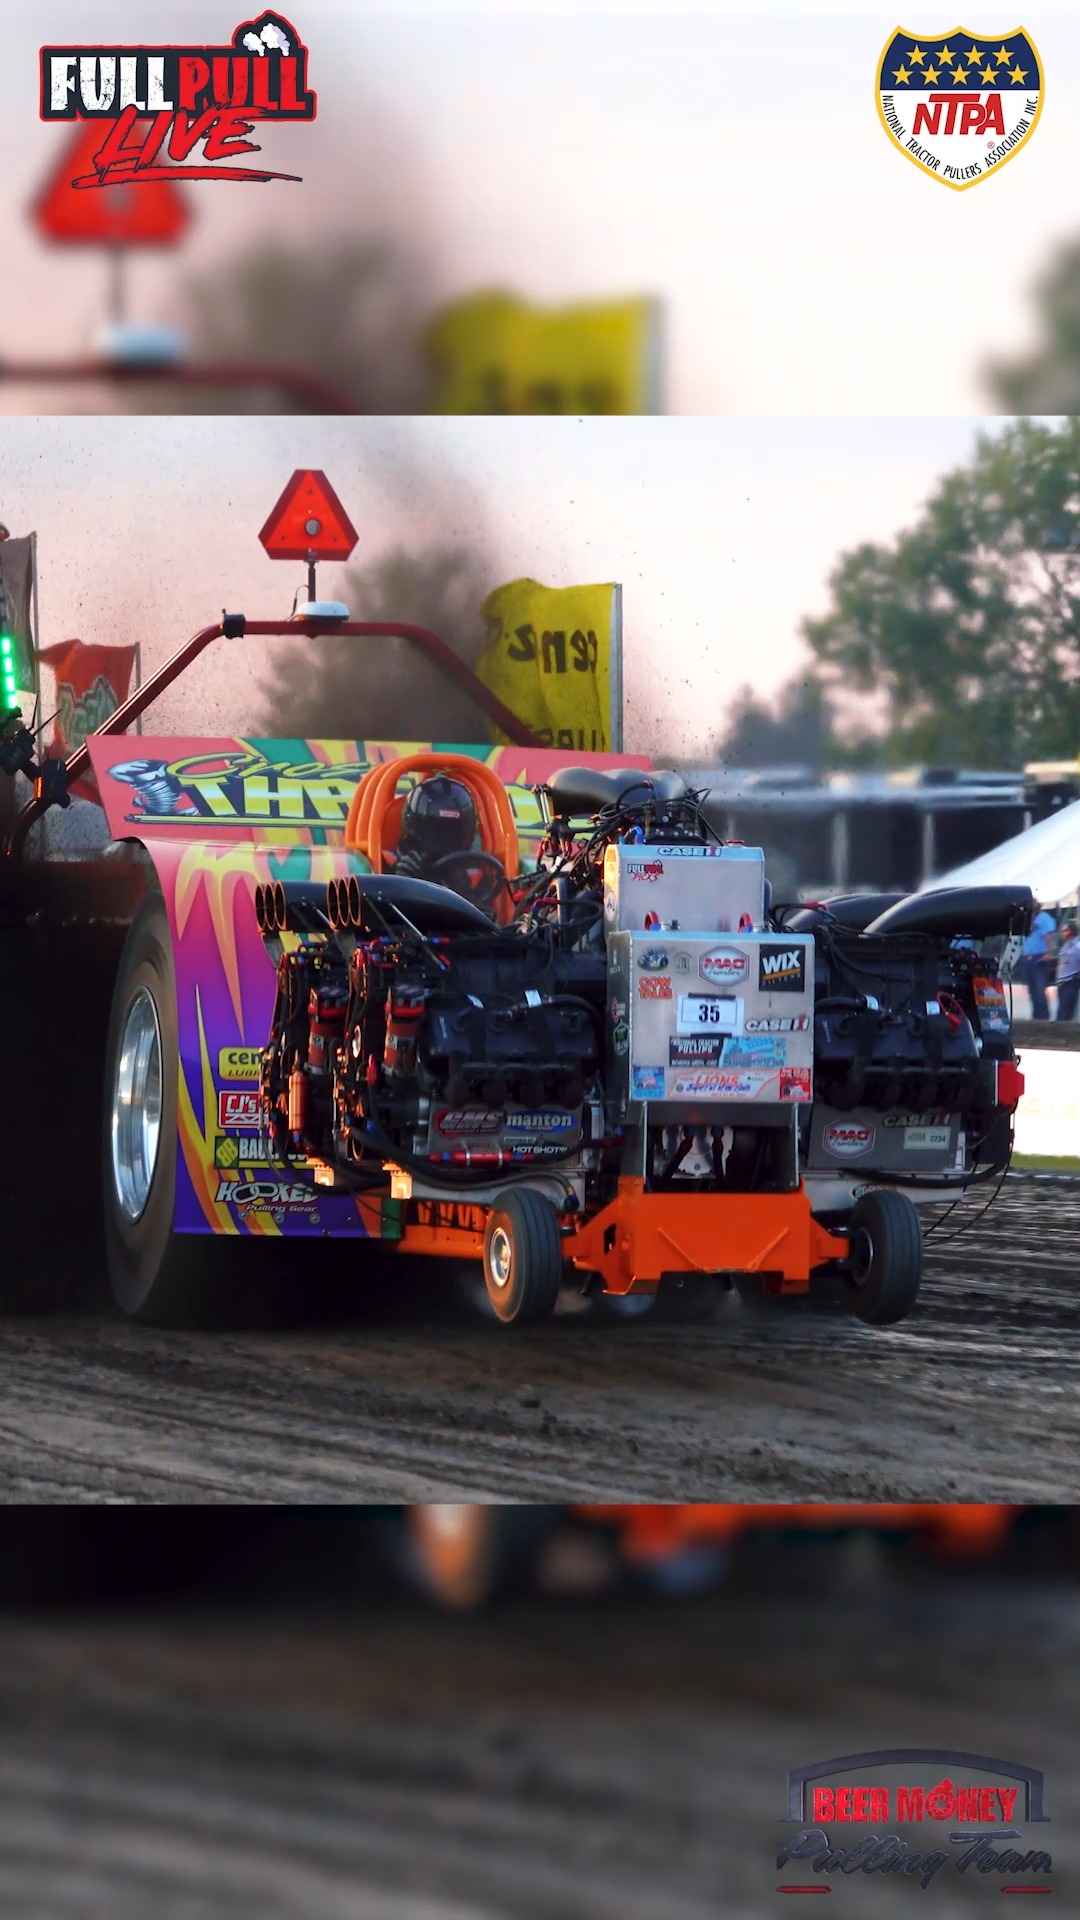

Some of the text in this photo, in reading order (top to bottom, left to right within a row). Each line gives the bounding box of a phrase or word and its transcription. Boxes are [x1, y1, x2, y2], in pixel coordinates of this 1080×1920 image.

[658, 847, 704, 856] CASE
[628, 864, 645, 873] FULL
[704, 957, 745, 969] MAG
[762, 950, 801, 976] WIX
[639, 976, 672, 988] COW
[699, 1005, 720, 1023] 35
[745, 1018, 790, 1032] CASE
[228, 1052, 263, 1065] cen
[695, 1075, 738, 1085] LIONS
[226, 1095, 257, 1113] CJ's
[506, 1114, 572, 1128] manton
[882, 1114, 930, 1128] CASE
[829, 1129, 869, 1141] MAG
[513, 1145, 533, 1153] HOT
[246, 1205, 317, 1213] Pulling Gear
